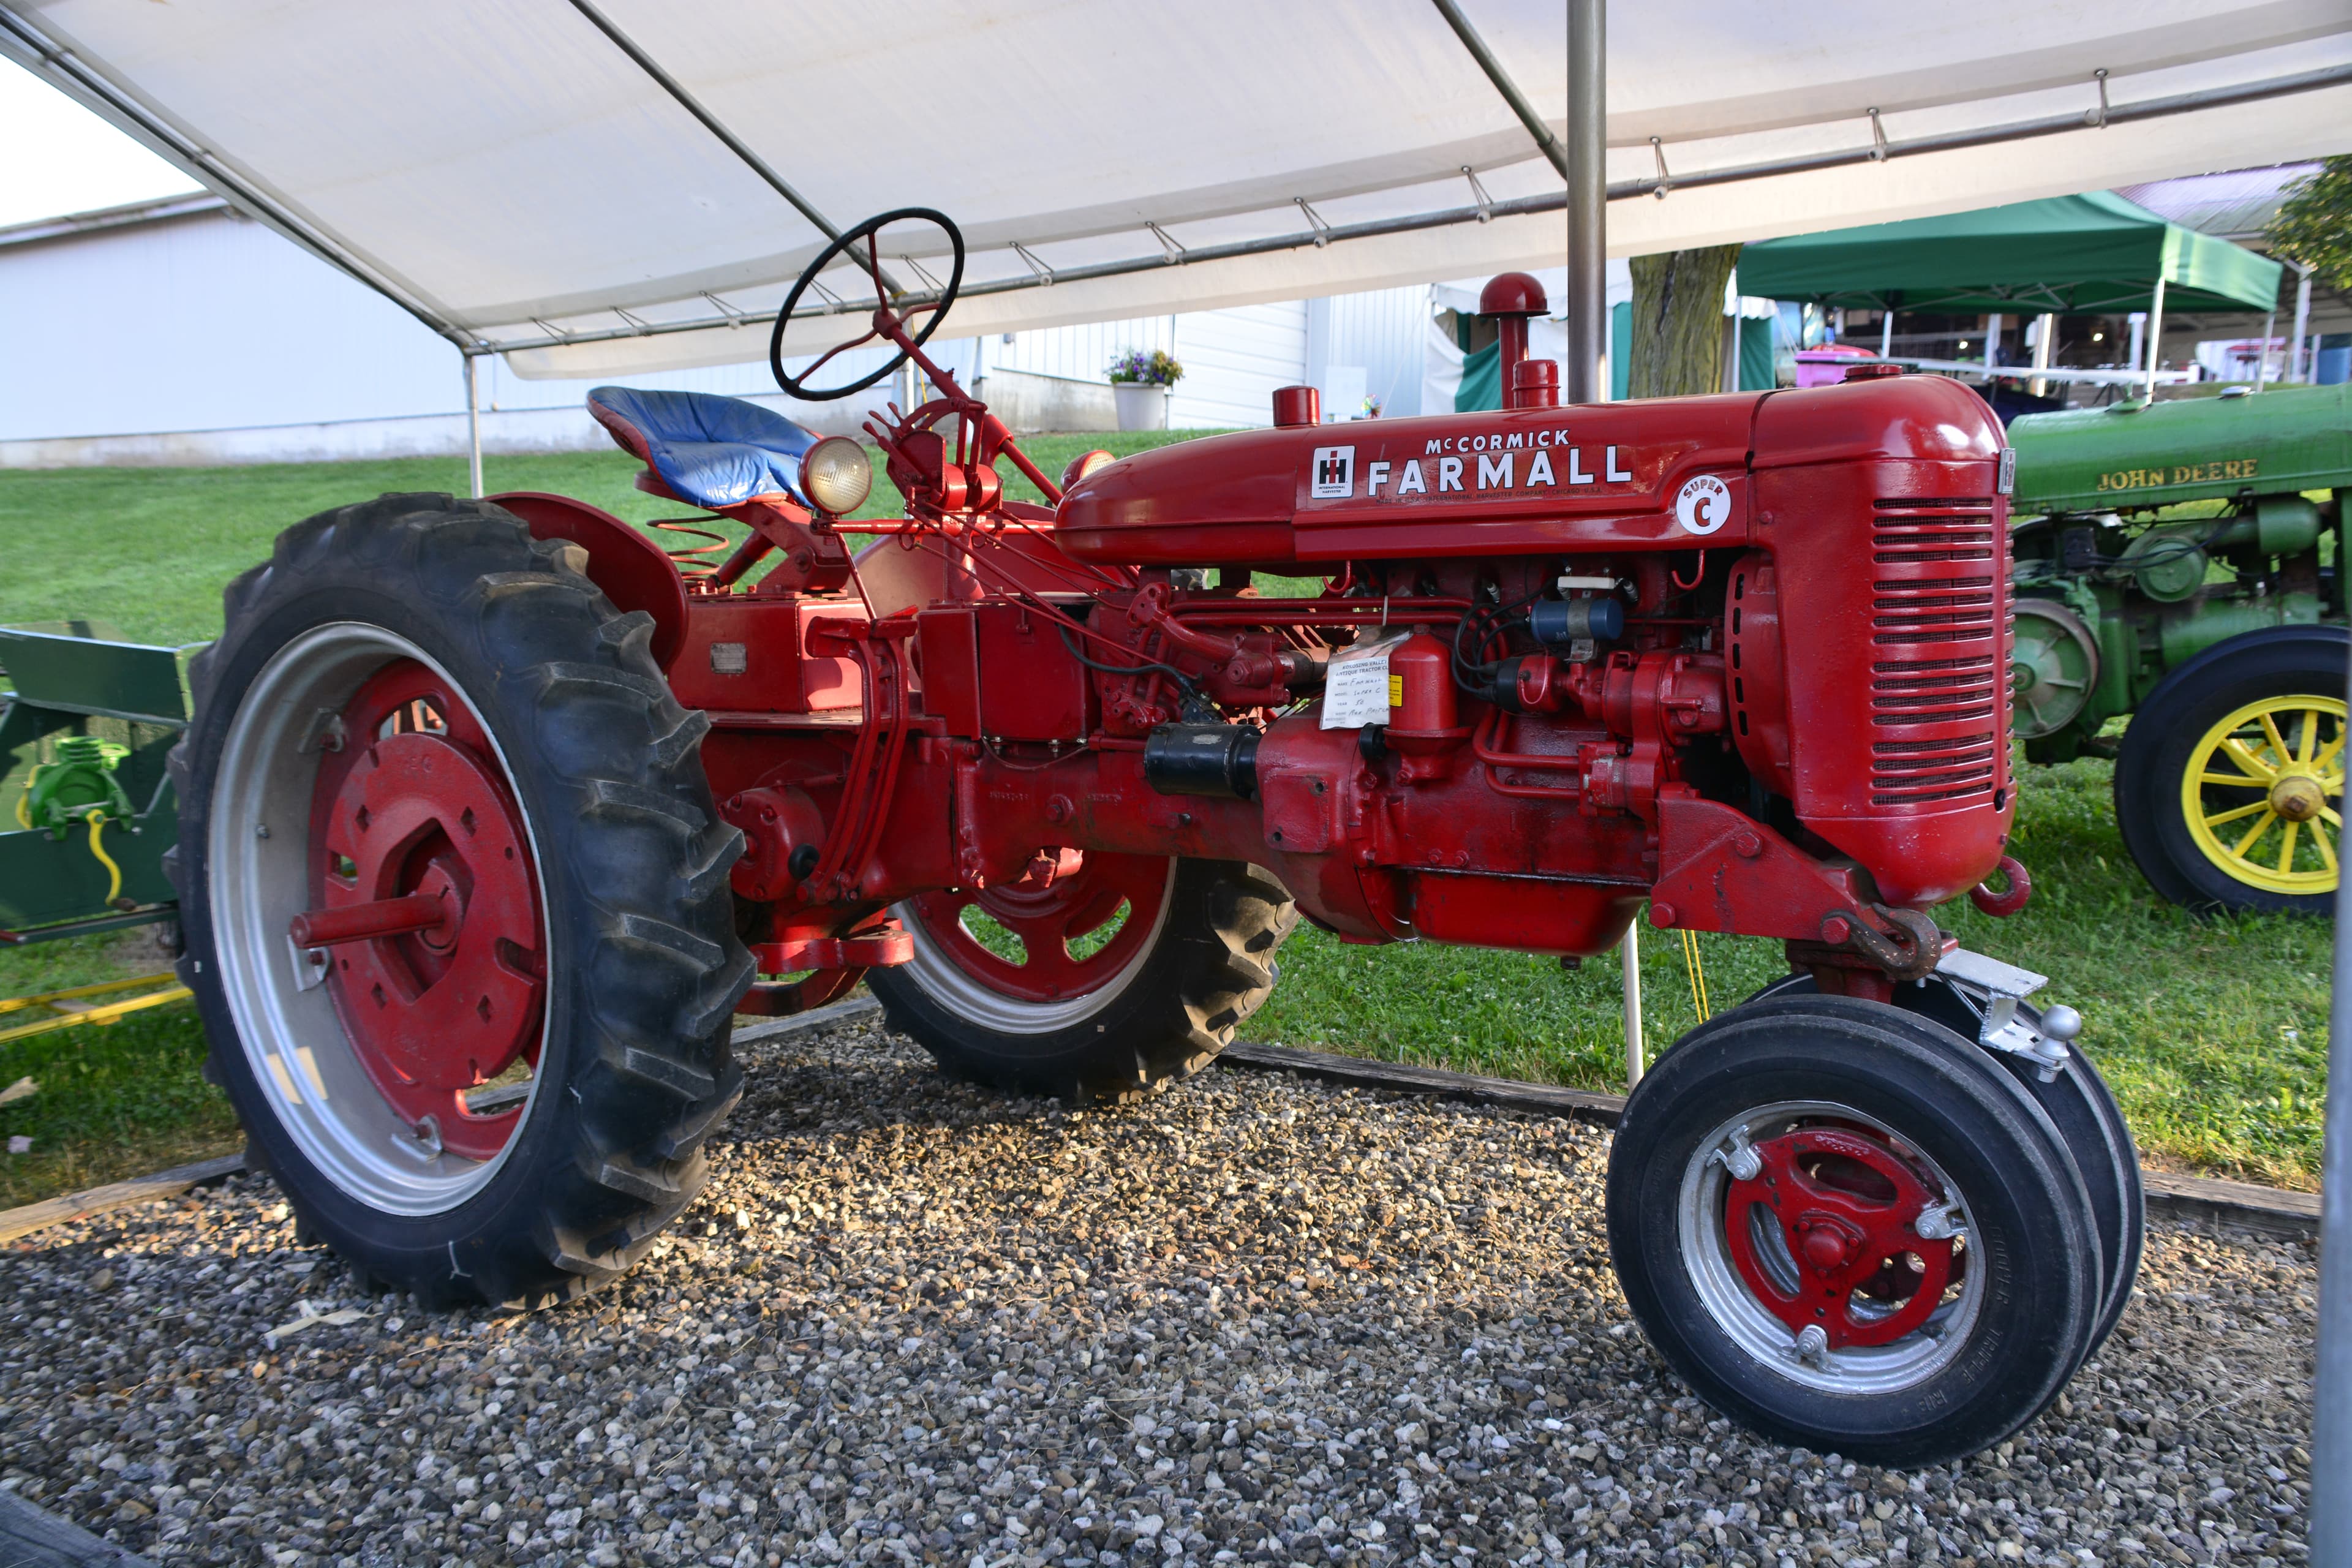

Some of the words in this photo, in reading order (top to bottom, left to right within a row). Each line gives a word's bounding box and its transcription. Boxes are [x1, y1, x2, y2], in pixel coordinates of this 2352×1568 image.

[1368, 444, 1632, 497] FARMALL
[2097, 468, 2166, 491] JOHN
[2173, 459, 2258, 484] DEERE
[1683, 479, 1723, 499] SUPER
[1694, 497, 1711, 527] C
